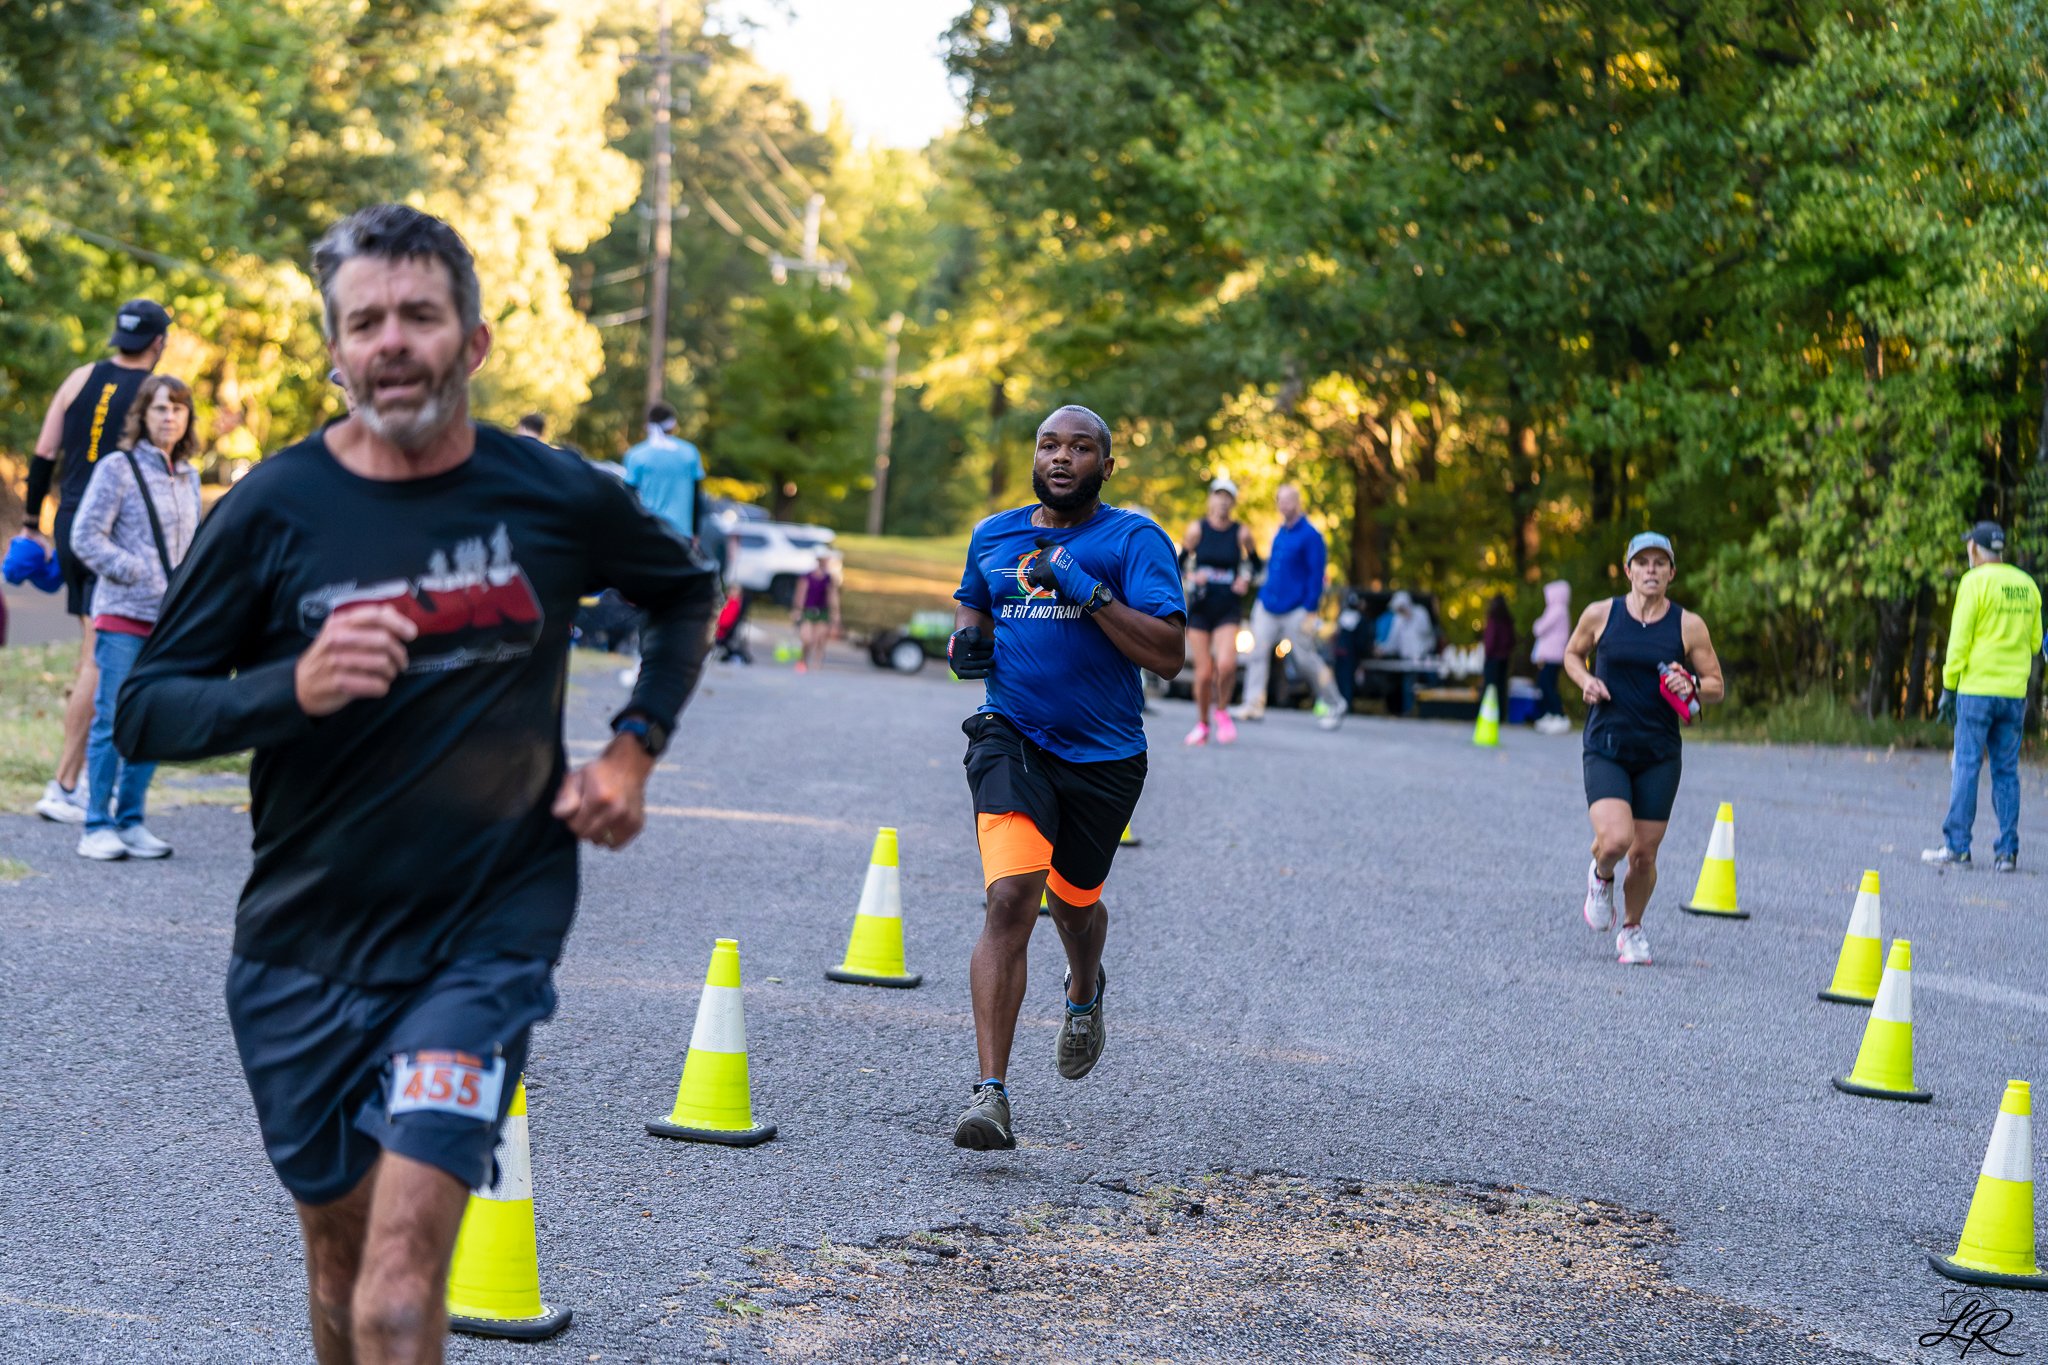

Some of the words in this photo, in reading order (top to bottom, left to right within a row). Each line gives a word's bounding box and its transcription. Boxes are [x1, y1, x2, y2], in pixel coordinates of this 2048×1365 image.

[1001, 604, 1013, 618] BE
[1013, 604, 1031, 619] FIT
[403, 1068, 481, 1108] 455
